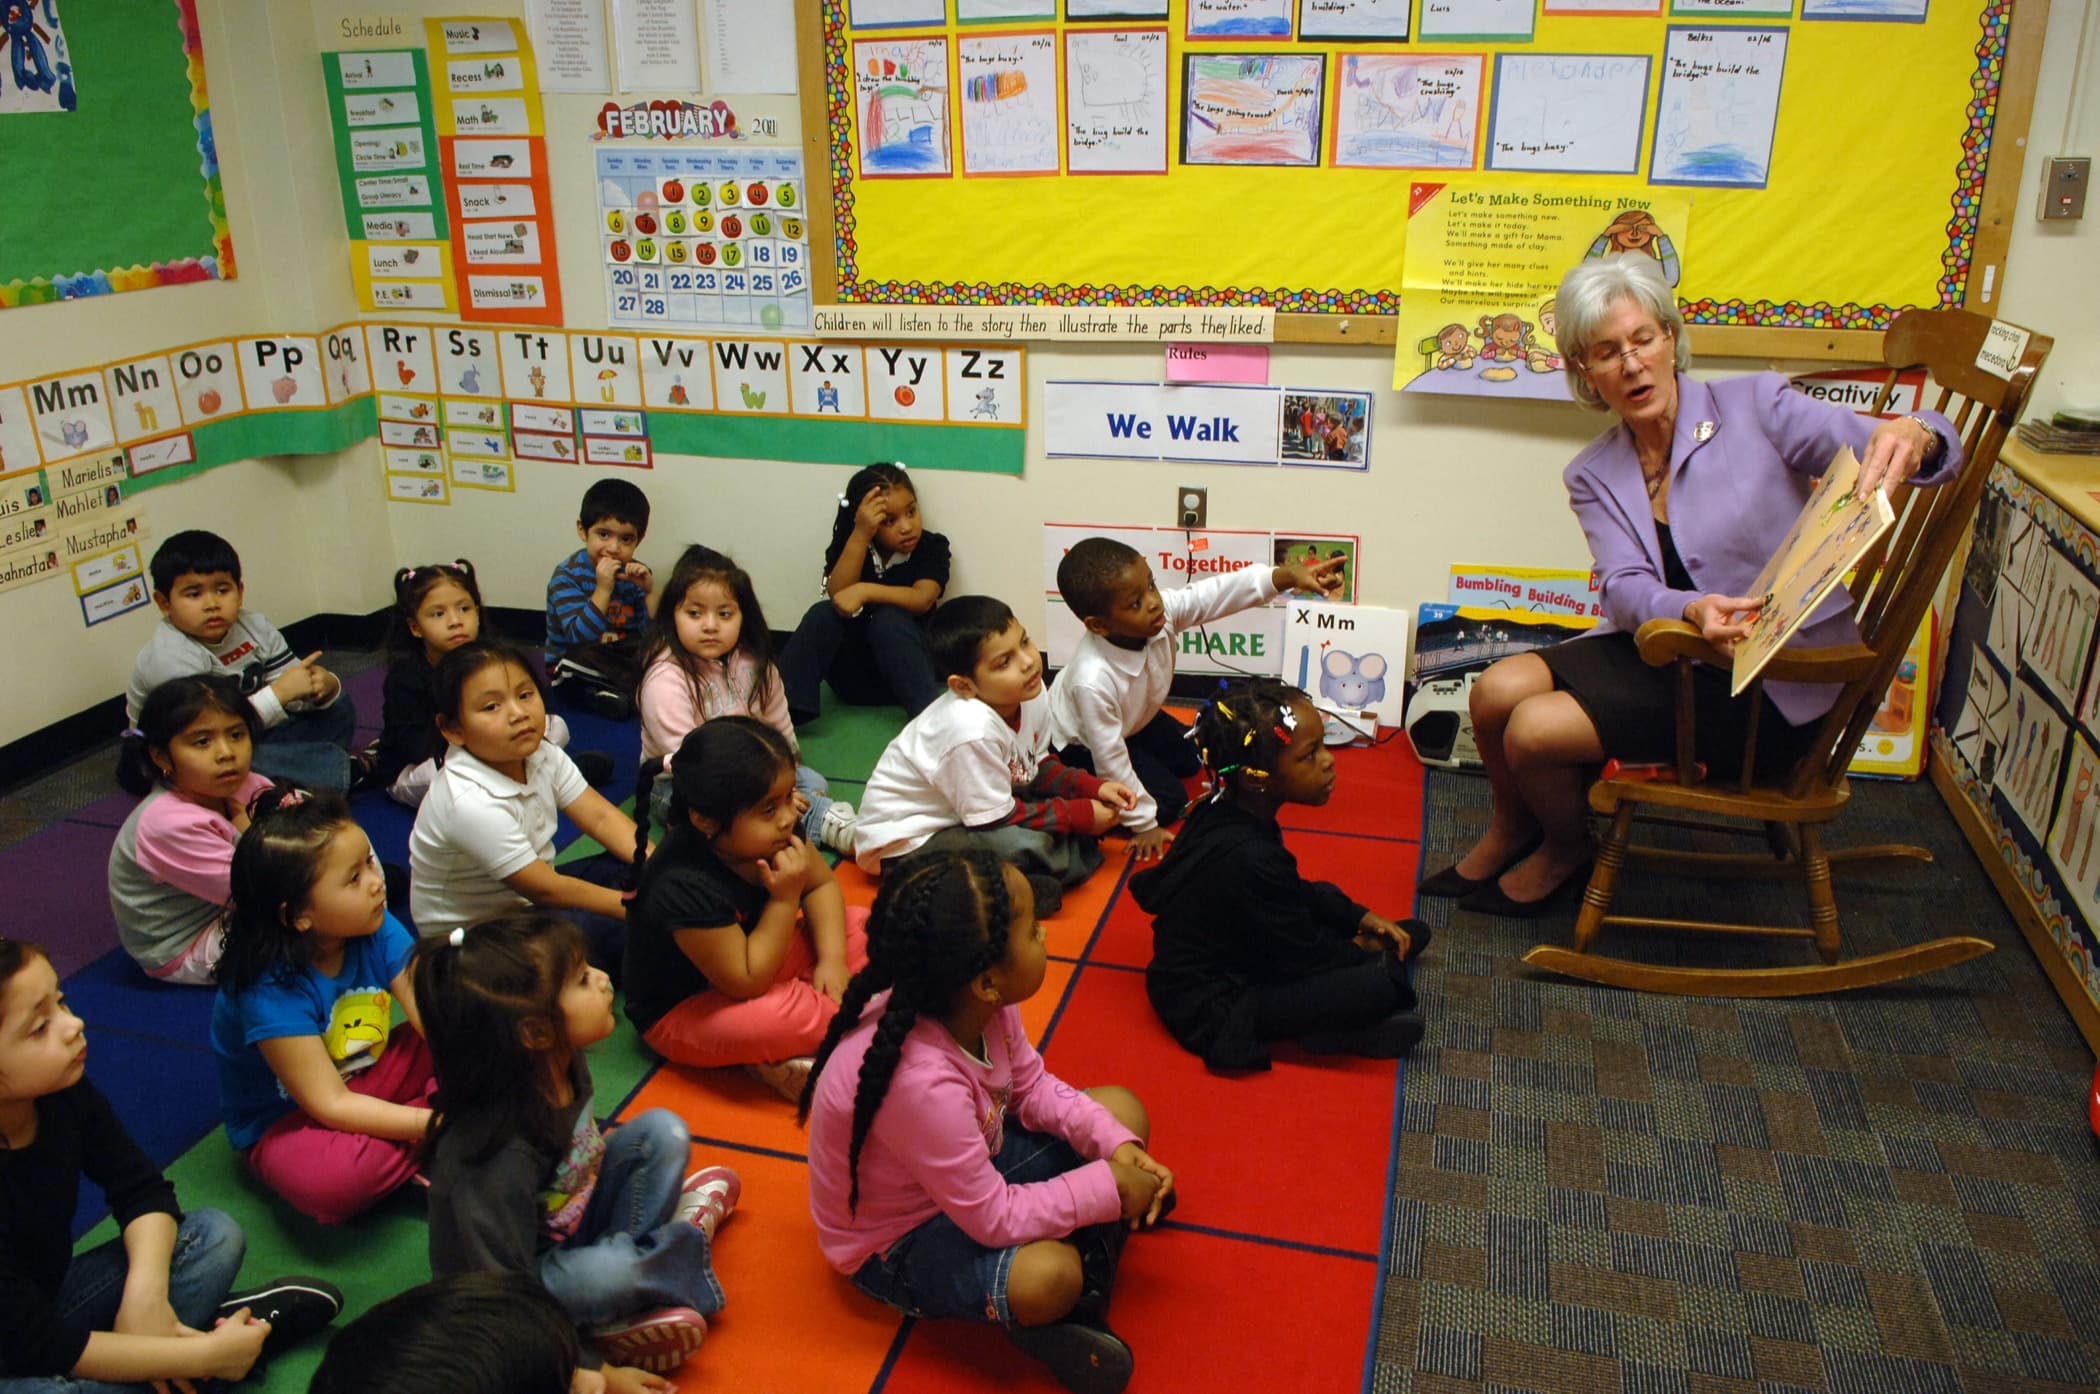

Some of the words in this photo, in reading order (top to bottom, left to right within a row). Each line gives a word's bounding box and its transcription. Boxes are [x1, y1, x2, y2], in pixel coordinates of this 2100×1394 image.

[341, 17, 402, 38] Schedule
[446, 29, 470, 39] Music
[1716, 62, 1742, 74] build
[1746, 65, 1760, 75] the
[451, 73, 482, 82] Recess
[456, 115, 479, 125] Math
[605, 108, 729, 138] FEBRUARY
[752, 117, 778, 136] 2011
[670, 188, 677, 197] 1
[698, 190, 706, 201] 2
[728, 189, 735, 200] 3
[753, 188, 762, 199] 4
[783, 190, 790, 201] 5
[463, 195, 490, 207] Snack
[1451, 192, 1485, 205] Let's
[1489, 193, 1529, 206] Make
[1533, 193, 1612, 211] Something
[1617, 197, 1652, 210] New
[700, 216, 708, 227] 9
[1449, 210, 1468, 218] Let's
[1471, 211, 1493, 219] make
[1496, 212, 1538, 222] something
[366, 221, 393, 231] Media
[613, 217, 621, 228] 6
[642, 219, 649, 229] 7
[672, 218, 680, 228] 8
[725, 221, 738, 233] 10
[755, 219, 766, 231] 11
[1448, 220, 1466, 228] Let's
[1504, 221, 1529, 231] today.
[787, 223, 800, 236] 12
[1446, 229, 1467, 238] We'll
[1470, 231, 1492, 239] make
[1504, 232, 1518, 241] gift
[1521, 232, 1533, 240] for
[1537, 233, 1564, 241] Mama.
[615, 246, 627, 257] 13
[640, 244, 652, 255] 14
[1446, 240, 1488, 249] Something
[1491, 241, 1513, 249] made
[1516, 241, 1526, 249] of
[1529, 242, 1547, 252] clay.
[672, 248, 684, 259] 15
[700, 248, 713, 260] 16
[725, 250, 738, 262] 17
[754, 246, 771, 262] 18
[781, 246, 798, 263] 19
[373, 258, 398, 268] Lunch
[1444, 259, 1464, 267] We'll
[1467, 260, 1484, 269] give
[1487, 260, 1500, 268] her
[1503, 262, 1526, 270] many
[1529, 262, 1549, 270] clues
[613, 269, 633, 286] 20
[781, 270, 802, 290] 26
[1467, 270, 1489, 278] hints.
[644, 273, 660, 289] 21
[670, 273, 693, 290] 22
[695, 273, 717, 290] 23
[724, 274, 745, 291] 24
[752, 275, 773, 291] 25
[1490, 280, 1503, 288] her
[1506, 281, 1524, 289] hide
[1527, 281, 1540, 289] her
[375, 290, 391, 299] P.E.
[473, 288, 511, 298] Dismissal
[1441, 288, 1468, 297] Maybe
[1471, 289, 1484, 297] she
[1488, 290, 1502, 298] will
[1505, 291, 1527, 299] guess
[618, 296, 636, 312] 27
[645, 299, 665, 315] 28
[1440, 297, 1455, 305] Our
[1458, 299, 1500, 307] marvelous
[1503, 300, 1540, 309] surprise!
[815, 312, 866, 332] Children
[872, 312, 892, 331] will
[899, 312, 931, 332] listen
[938, 312, 948, 331] to
[953, 313, 973, 332] the
[981, 313, 1014, 338] story
[1020, 313, 1047, 333] then
[1058, 313, 1118, 334] illustrate
[1126, 314, 1149, 334] the
[1159, 314, 1193, 340] parts
[1201, 314, 1228, 341] they
[1229, 314, 1266, 335] liked.
[1168, 346, 1208, 361] Rules
[1791, 380, 1901, 411] reativiy
[1107, 413, 1152, 439] We
[1167, 414, 1239, 443] Walk
[62, 460, 113, 489] Marielis
[56, 490, 103, 520] Mahlet
[66, 522, 127, 556] Mustapha
[1158, 552, 1253, 575] Together
[1456, 575, 1522, 598] Bumbling
[1528, 588, 1586, 616] Building
[1176, 631, 1265, 657] HARE
